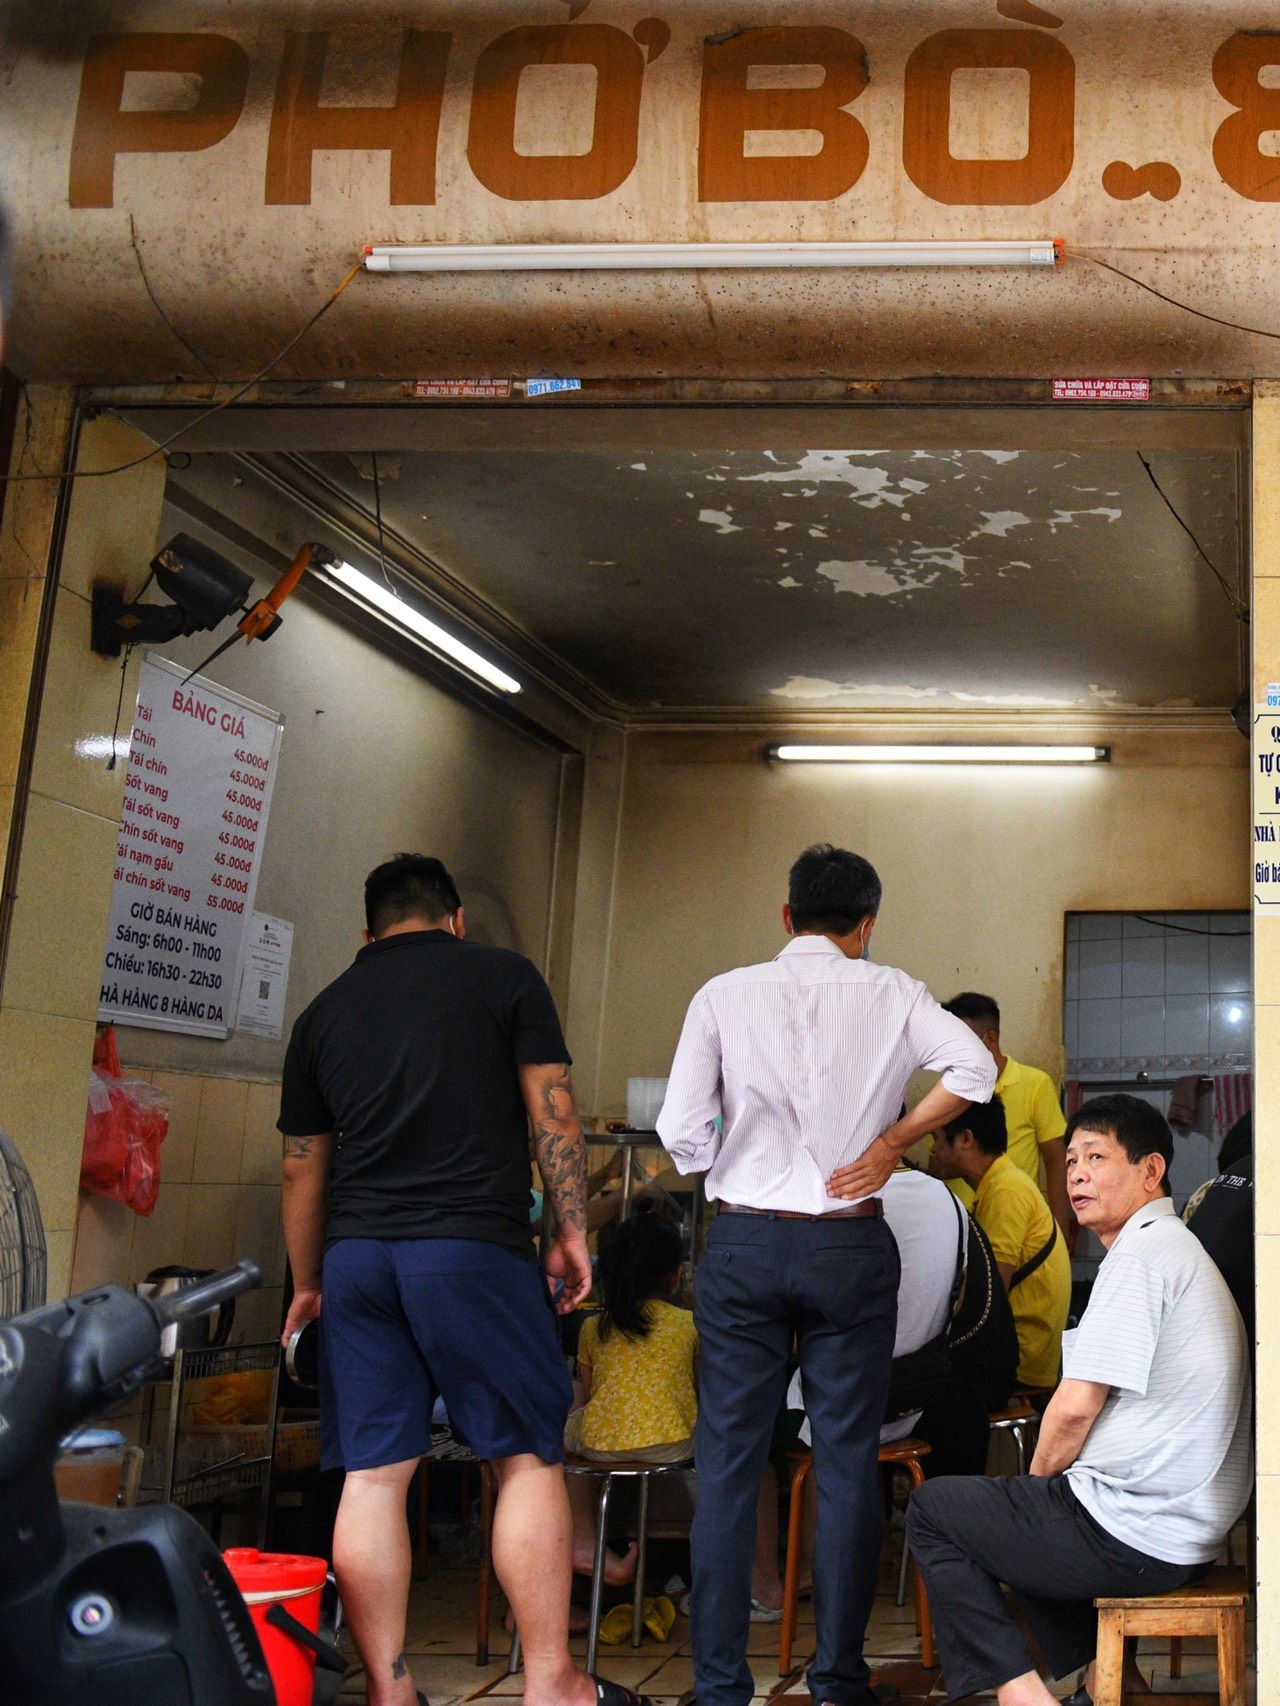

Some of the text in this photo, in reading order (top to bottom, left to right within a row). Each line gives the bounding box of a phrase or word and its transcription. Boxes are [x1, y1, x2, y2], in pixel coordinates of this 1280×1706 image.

[171, 690, 245, 740] BẢNG GIÁ
[132, 727, 266, 791] Chín 45.000đ
[137, 705, 269, 771] Tái 45.000đ
[129, 750, 262, 812] Tái chín 45.000đ
[1259, 752, 1274, 777] TỰ
[125, 774, 259, 832] Sốt vang 45.000đ
[137, 803, 154, 819] sốt
[156, 811, 180, 829] vang
[218, 831, 255, 852] 45.000đ
[1254, 821, 1276, 842] NHÀ
[117, 842, 127, 857] ái
[129, 849, 152, 866] nạm
[210, 873, 248, 894] 45.000đ
[141, 828, 158, 844] sốt
[160, 835, 184, 854] vang
[214, 852, 252, 873] 45.000đ
[1255, 860, 1270, 883] Giờ
[125, 872, 148, 888] chín
[150, 877, 166, 894] sốt
[167, 884, 191, 902] vang
[206, 894, 244, 915] 55.000đ
[130, 902, 217, 937] GIỜ BÁN HÀNG
[116, 924, 150, 949] Sáng:
[153, 933, 183, 953] 6h00
[192, 942, 222, 962] 11h00
[105, 952, 145, 974] Chiều:
[147, 960, 180, 981] 16h30
[189, 970, 222, 989] 22h30
[121, 986, 159, 1011] HÀNG
[161, 997, 169, 1012] 8
[171, 996, 204, 1019] HÀNG
[207, 1005, 223, 1022] DA
